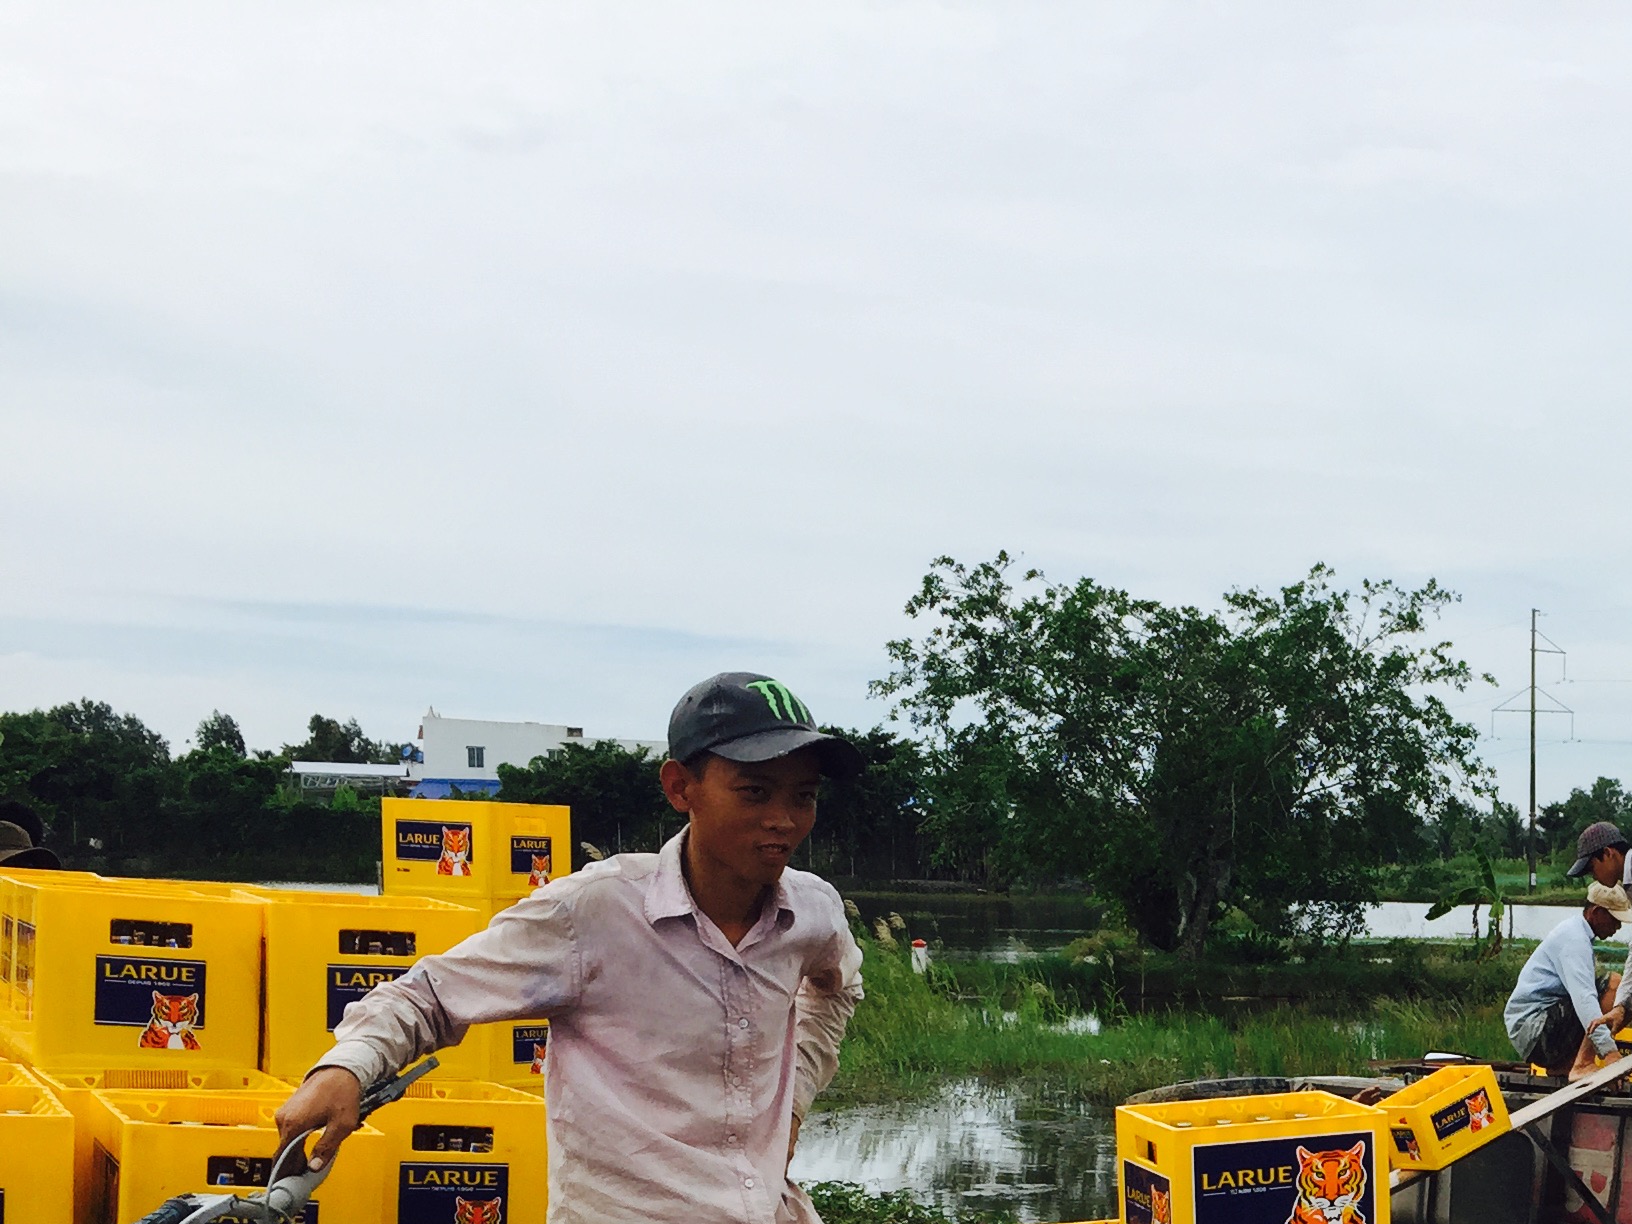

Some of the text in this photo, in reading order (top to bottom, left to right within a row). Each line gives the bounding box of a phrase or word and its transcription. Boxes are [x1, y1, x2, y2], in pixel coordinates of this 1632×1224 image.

[399, 832, 440, 845] LARUE
[513, 839, 548, 849] LARUE
[104, 963, 196, 982] LARUE
[1435, 1107, 1466, 1129] LARUE
[408, 1169, 498, 1186] LARUE
[1202, 1165, 1293, 1190] LARUE
[1126, 1185, 1152, 1208] LARUE
